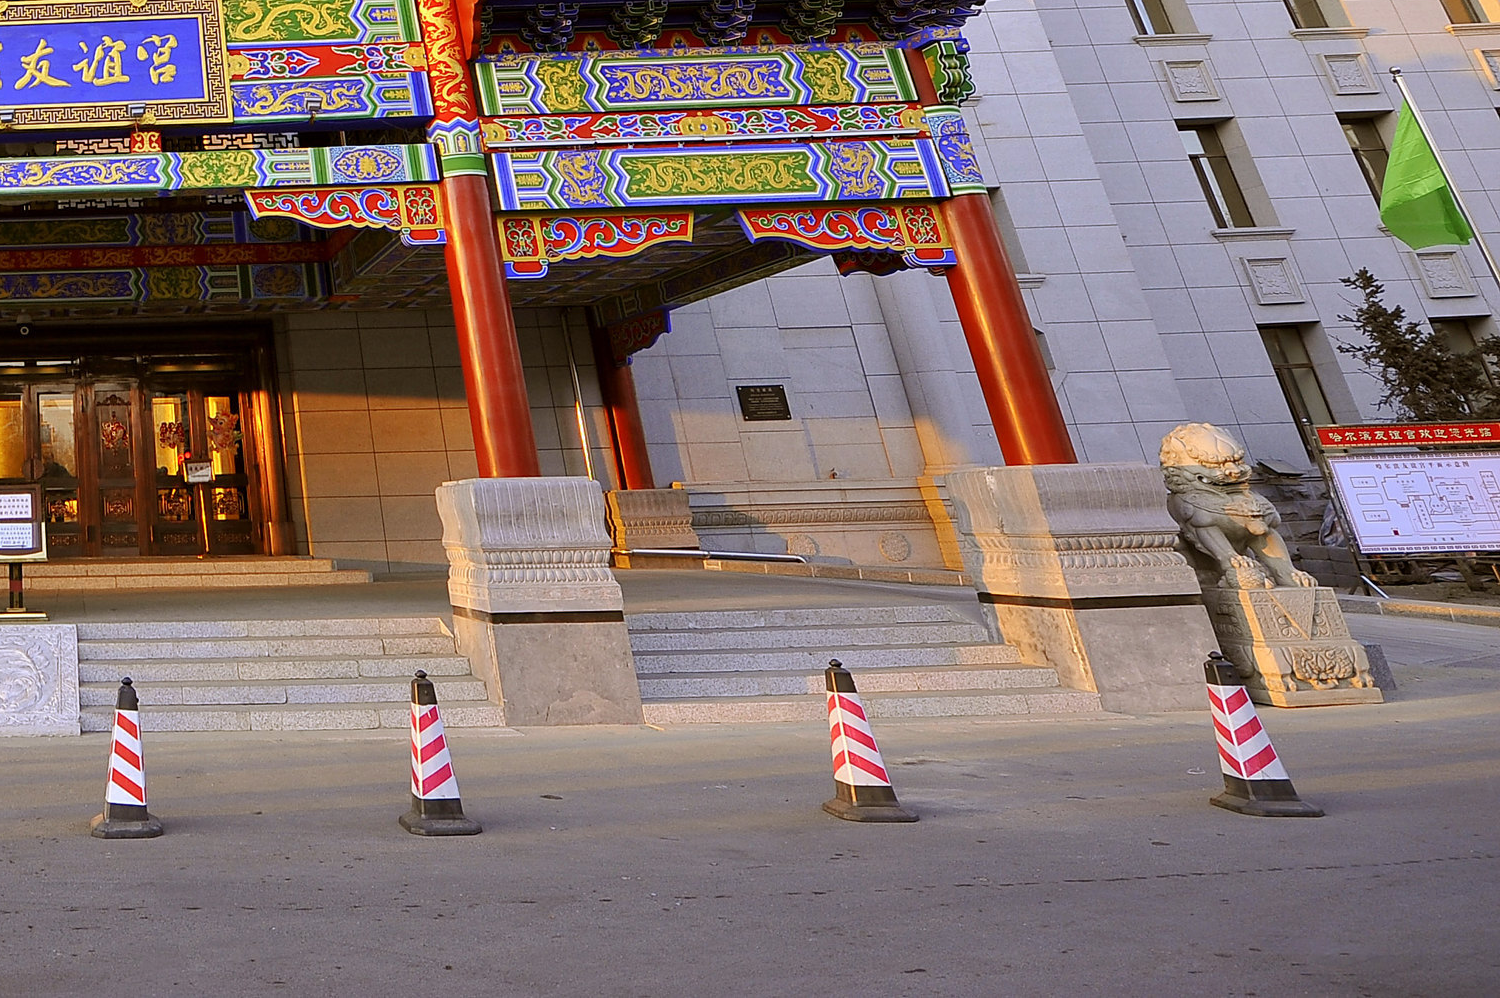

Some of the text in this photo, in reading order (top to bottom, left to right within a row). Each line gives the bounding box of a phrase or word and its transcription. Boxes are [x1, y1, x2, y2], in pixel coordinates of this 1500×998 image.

[1328, 428, 1492, 442] 哈尔滨友谊宫欢迎您光临
